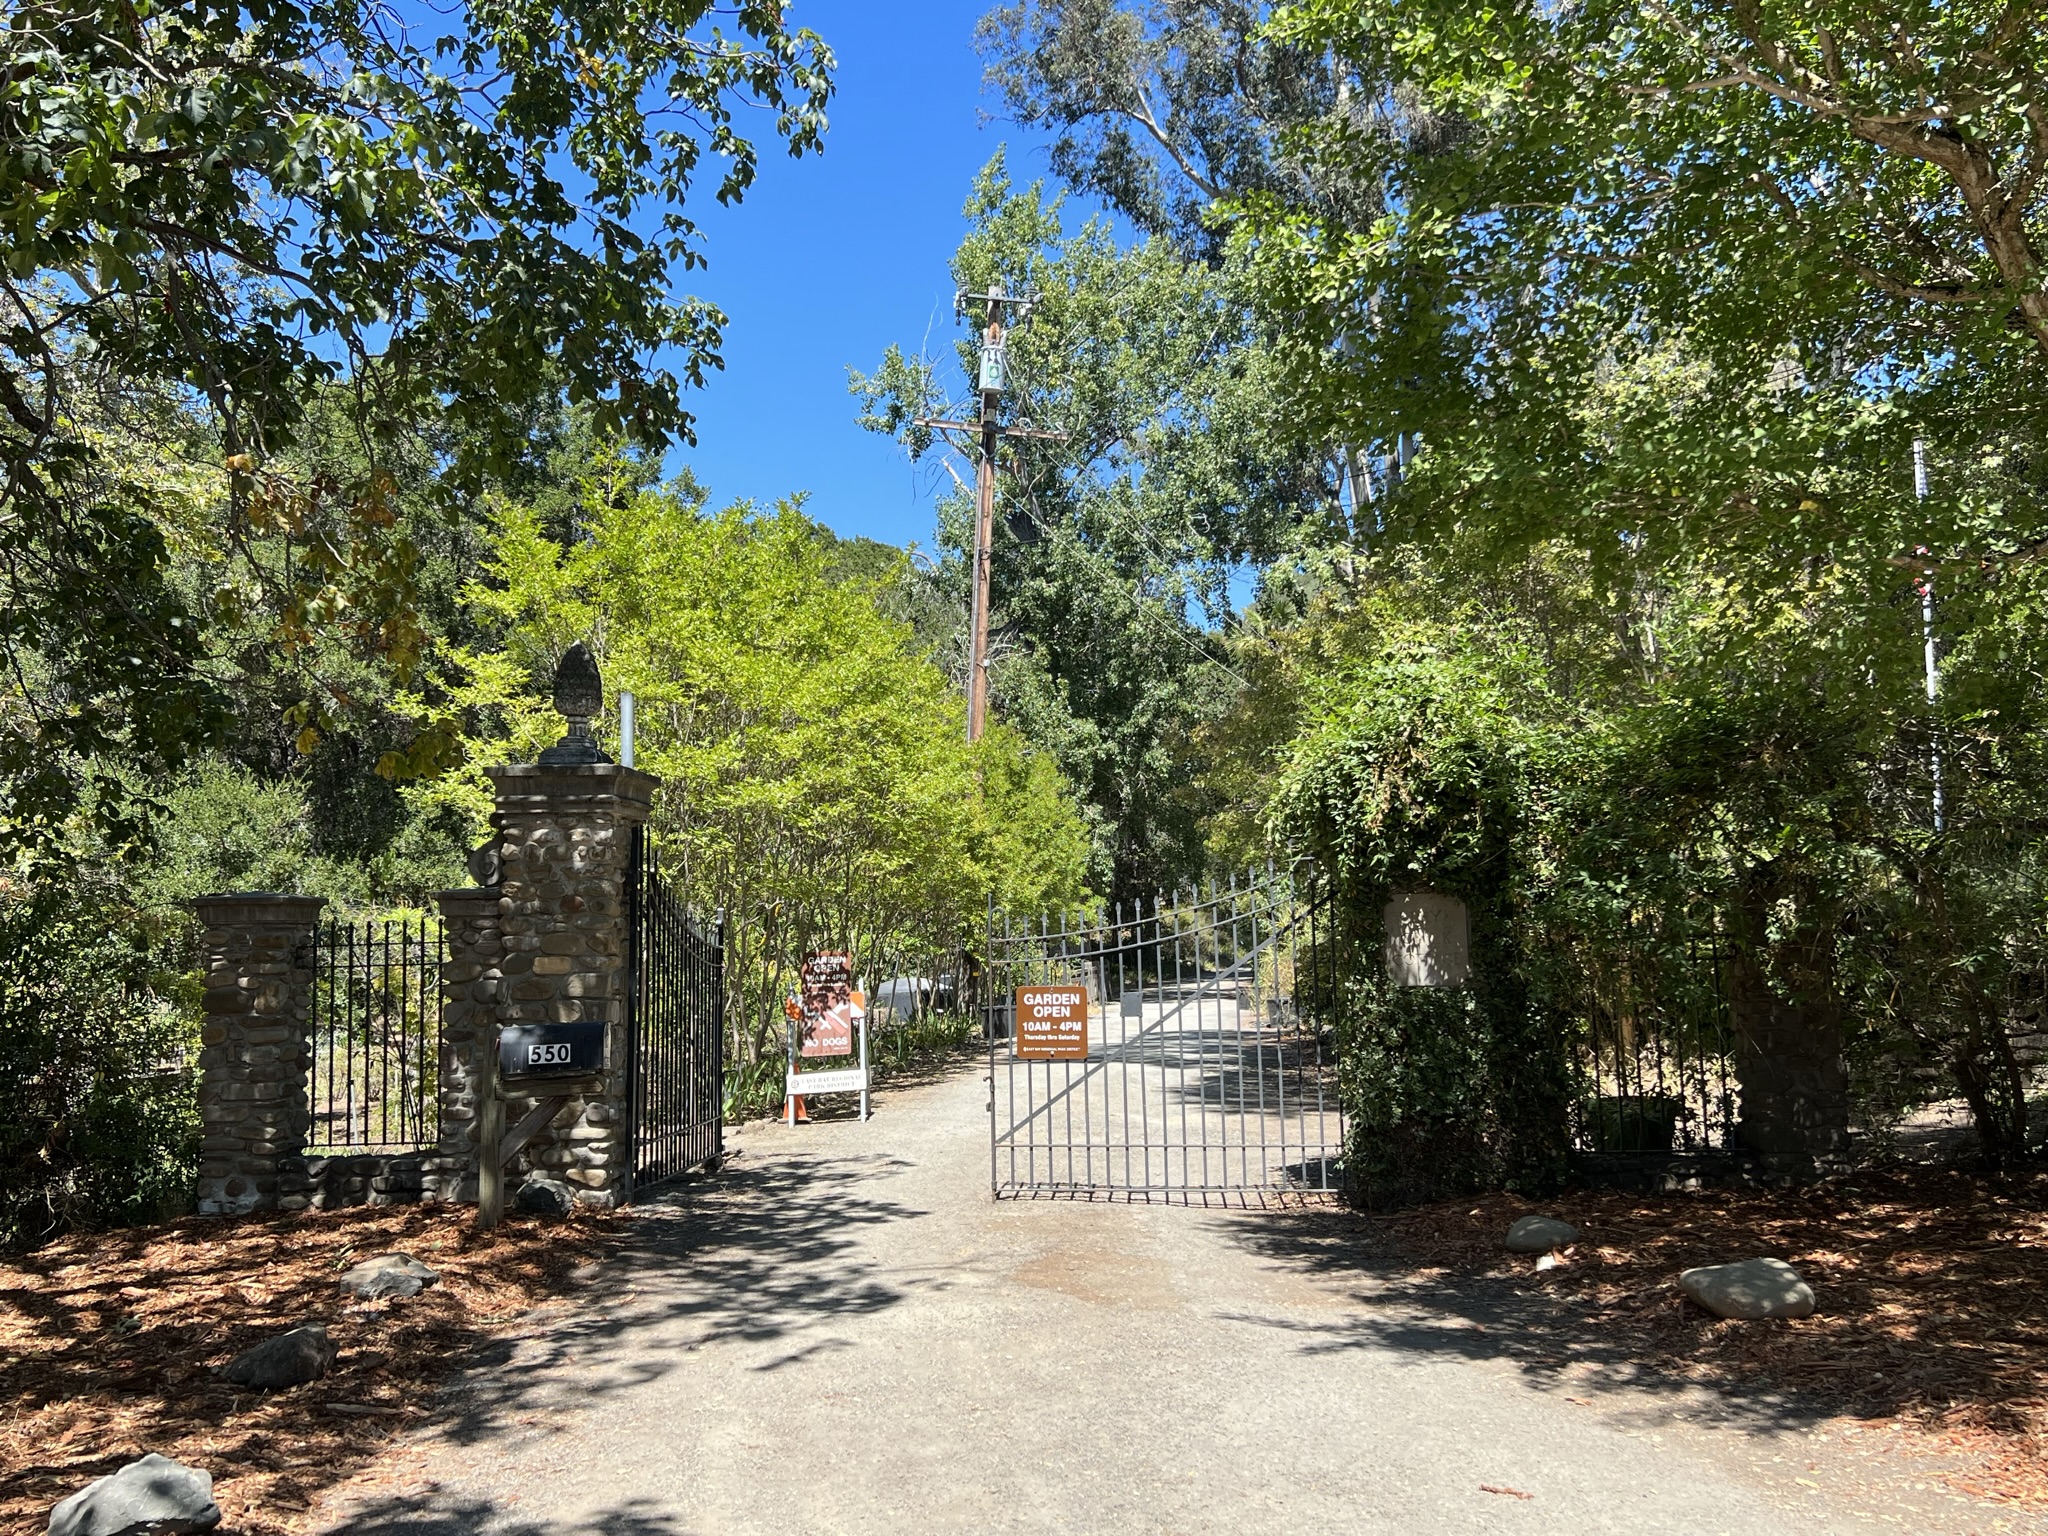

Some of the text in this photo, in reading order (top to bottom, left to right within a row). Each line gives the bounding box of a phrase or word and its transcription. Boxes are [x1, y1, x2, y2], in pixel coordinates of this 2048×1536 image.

[807, 956, 847, 966] GARDEN
[814, 964, 840, 972] OPEN
[1023, 993, 1080, 1005] GARDEN
[1033, 1006, 1070, 1018] OPEN
[1022, 1021, 1051, 1031] 10AM
[1059, 1021, 1082, 1031] 4PM
[804, 1037, 848, 1048] NO DOGS
[531, 1044, 569, 1063] 550
